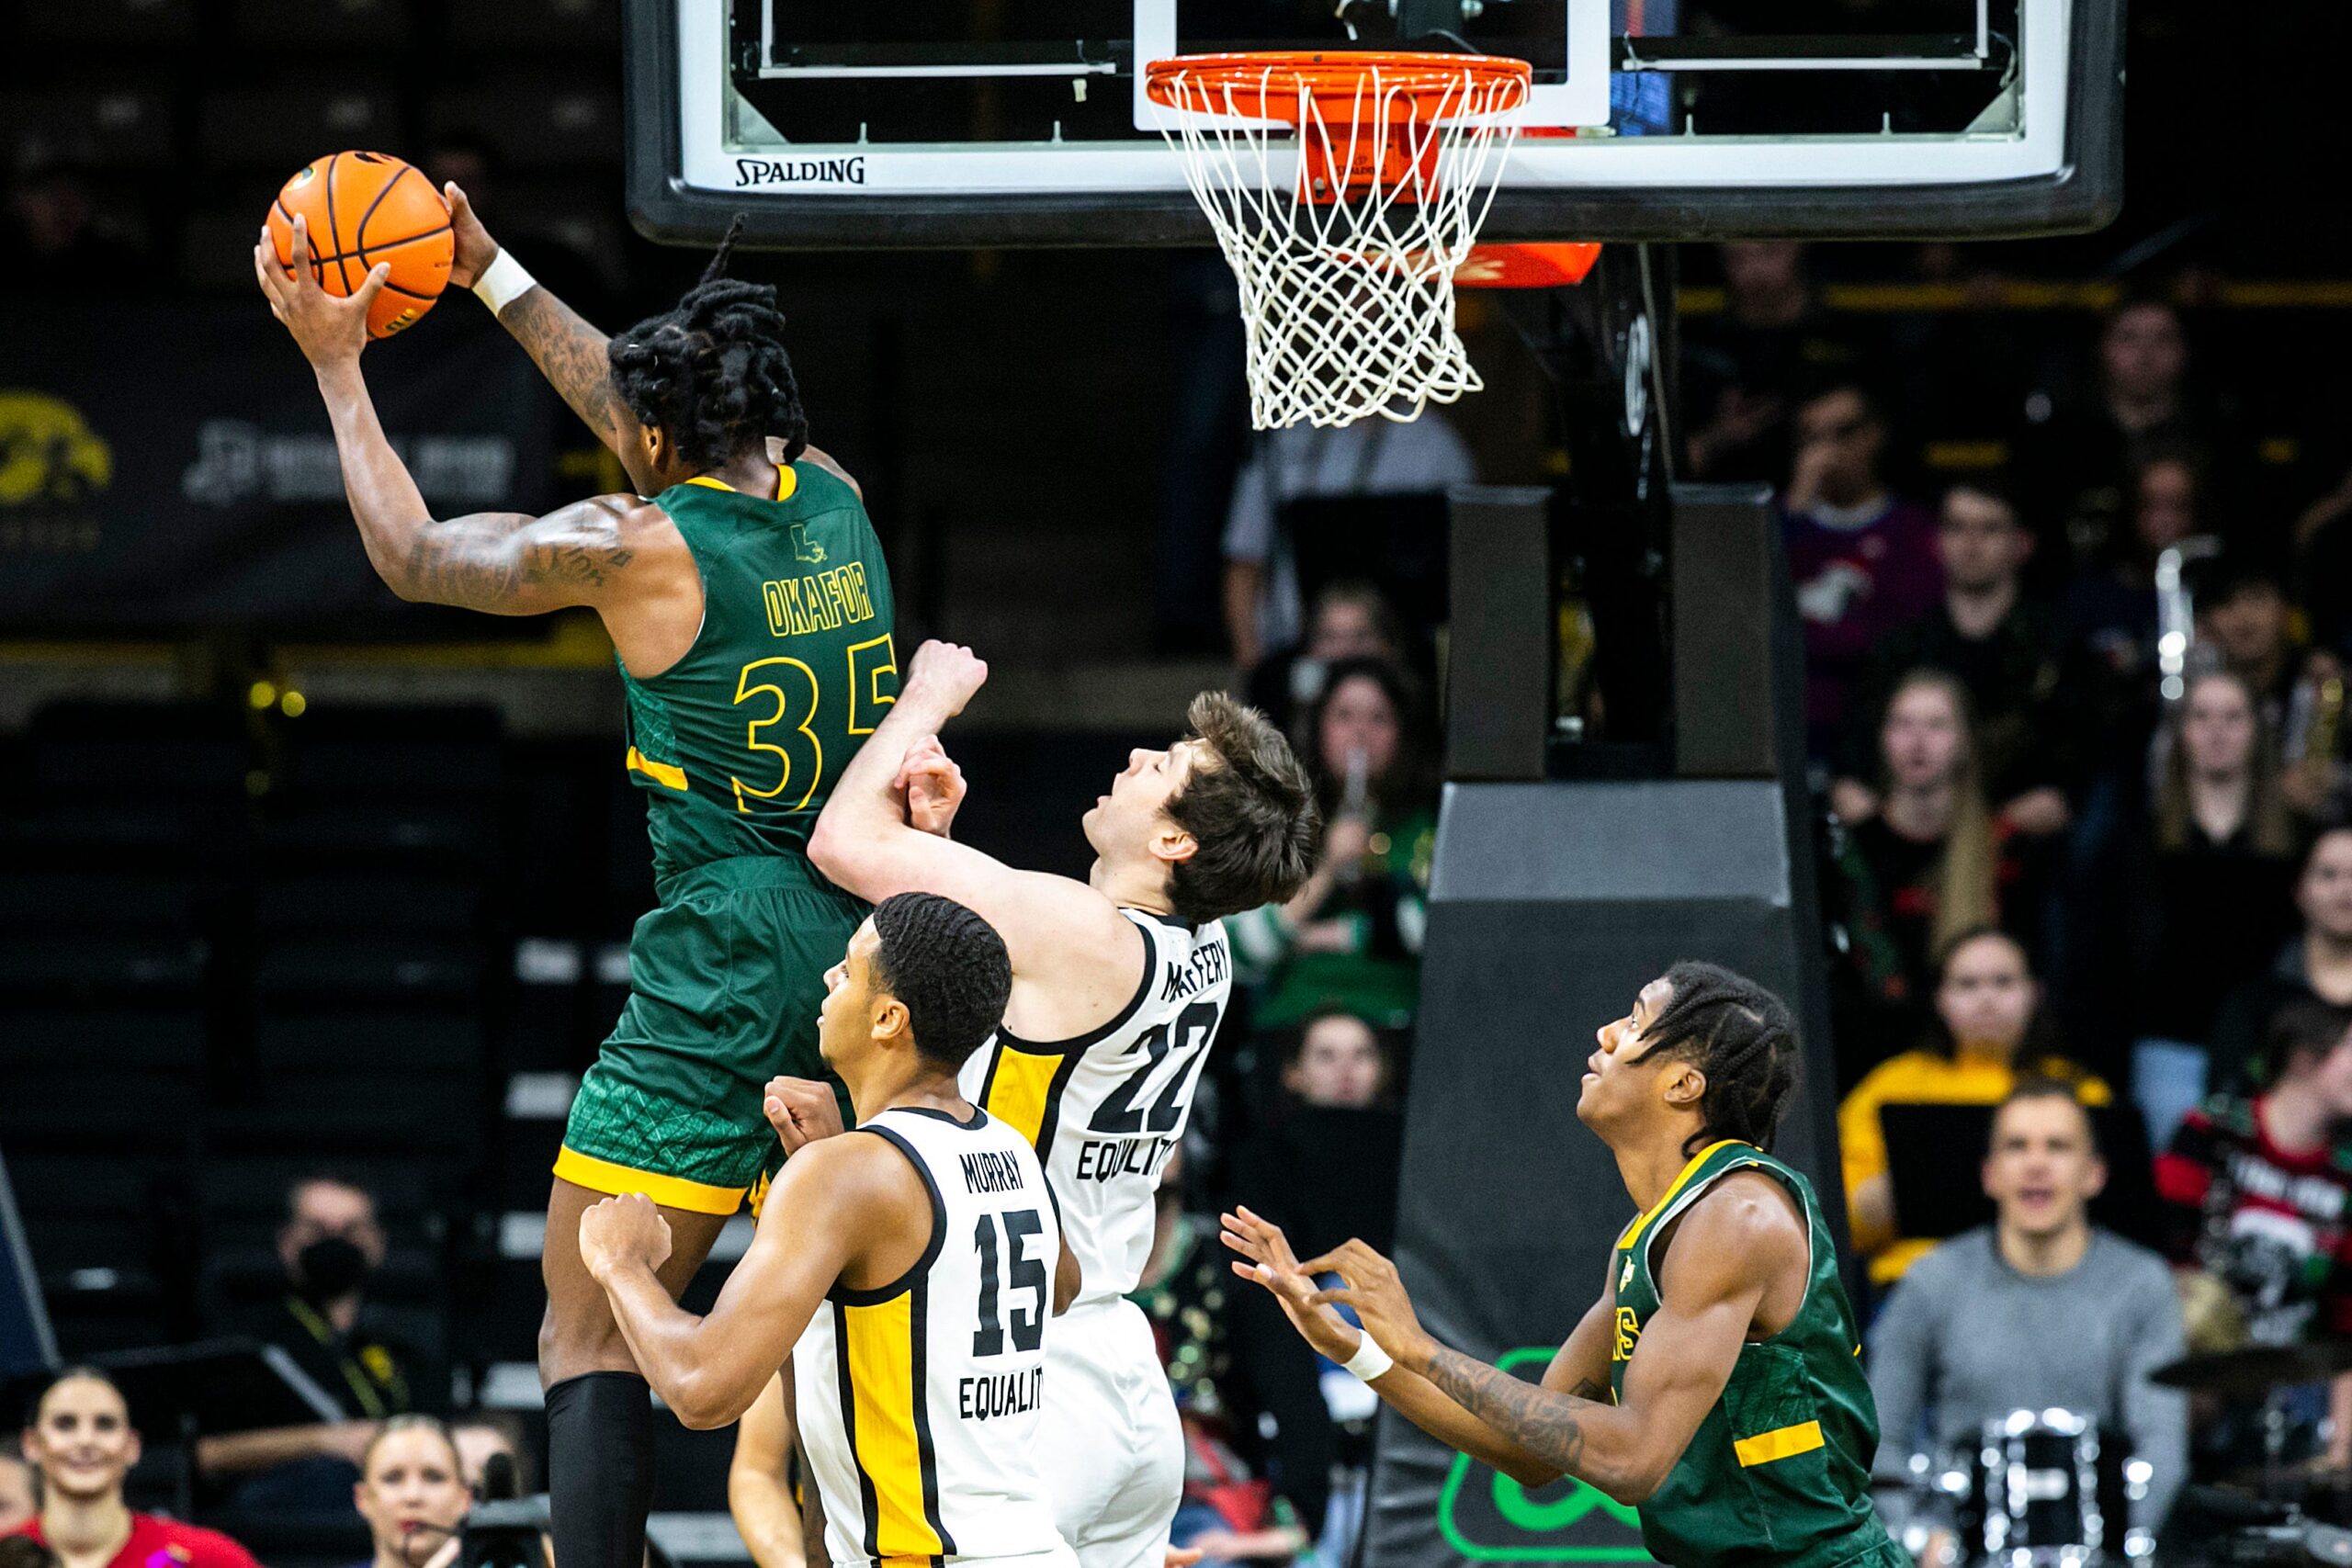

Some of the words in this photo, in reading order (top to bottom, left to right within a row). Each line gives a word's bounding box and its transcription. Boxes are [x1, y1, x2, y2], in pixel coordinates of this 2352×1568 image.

[736, 156, 864, 186] SPALDING
[763, 561, 875, 637] OKAFOR
[730, 632, 898, 814] 35
[1086, 1002, 1219, 1134] 22
[958, 1150, 1023, 1194] MURRAY
[972, 1209, 1046, 1357] 15
[959, 1366, 1044, 1421] EQUALIT
